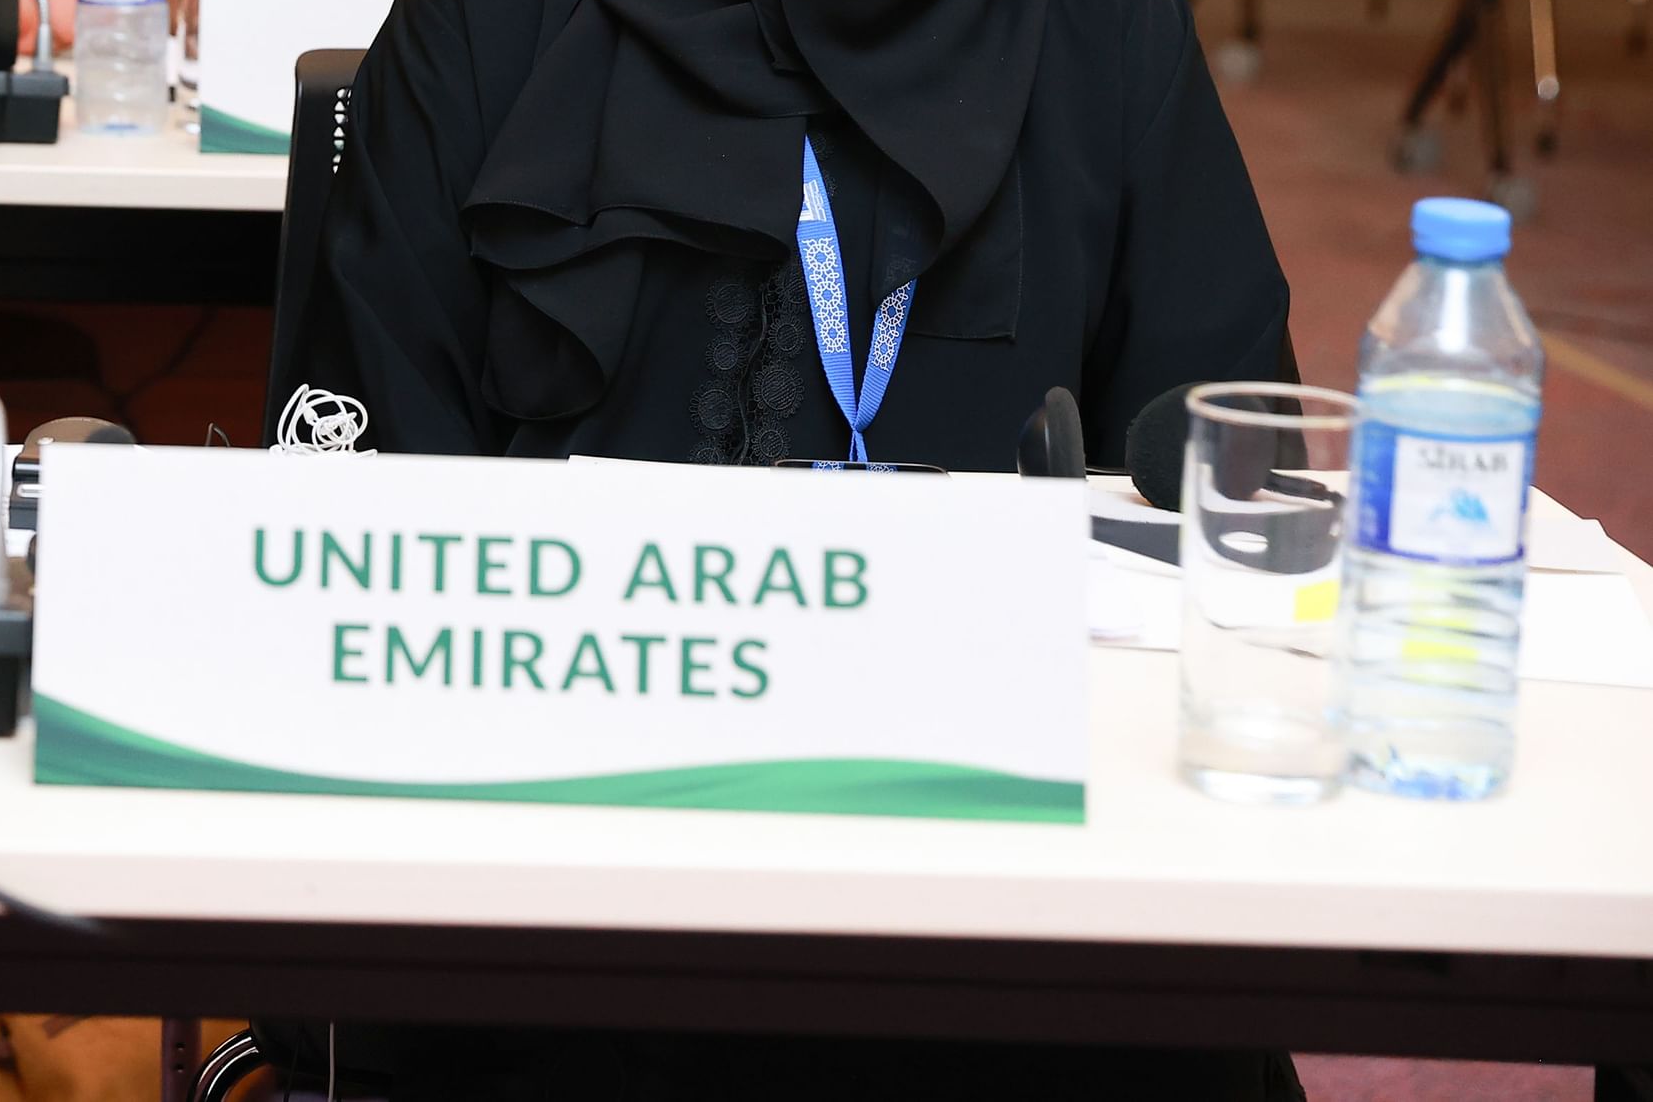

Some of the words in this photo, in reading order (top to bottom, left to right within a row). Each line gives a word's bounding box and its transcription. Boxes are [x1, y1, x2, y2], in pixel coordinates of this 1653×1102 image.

[254, 528, 582, 596] UNITED
[623, 542, 869, 609] ARAB
[332, 624, 769, 699] EMIRATES
